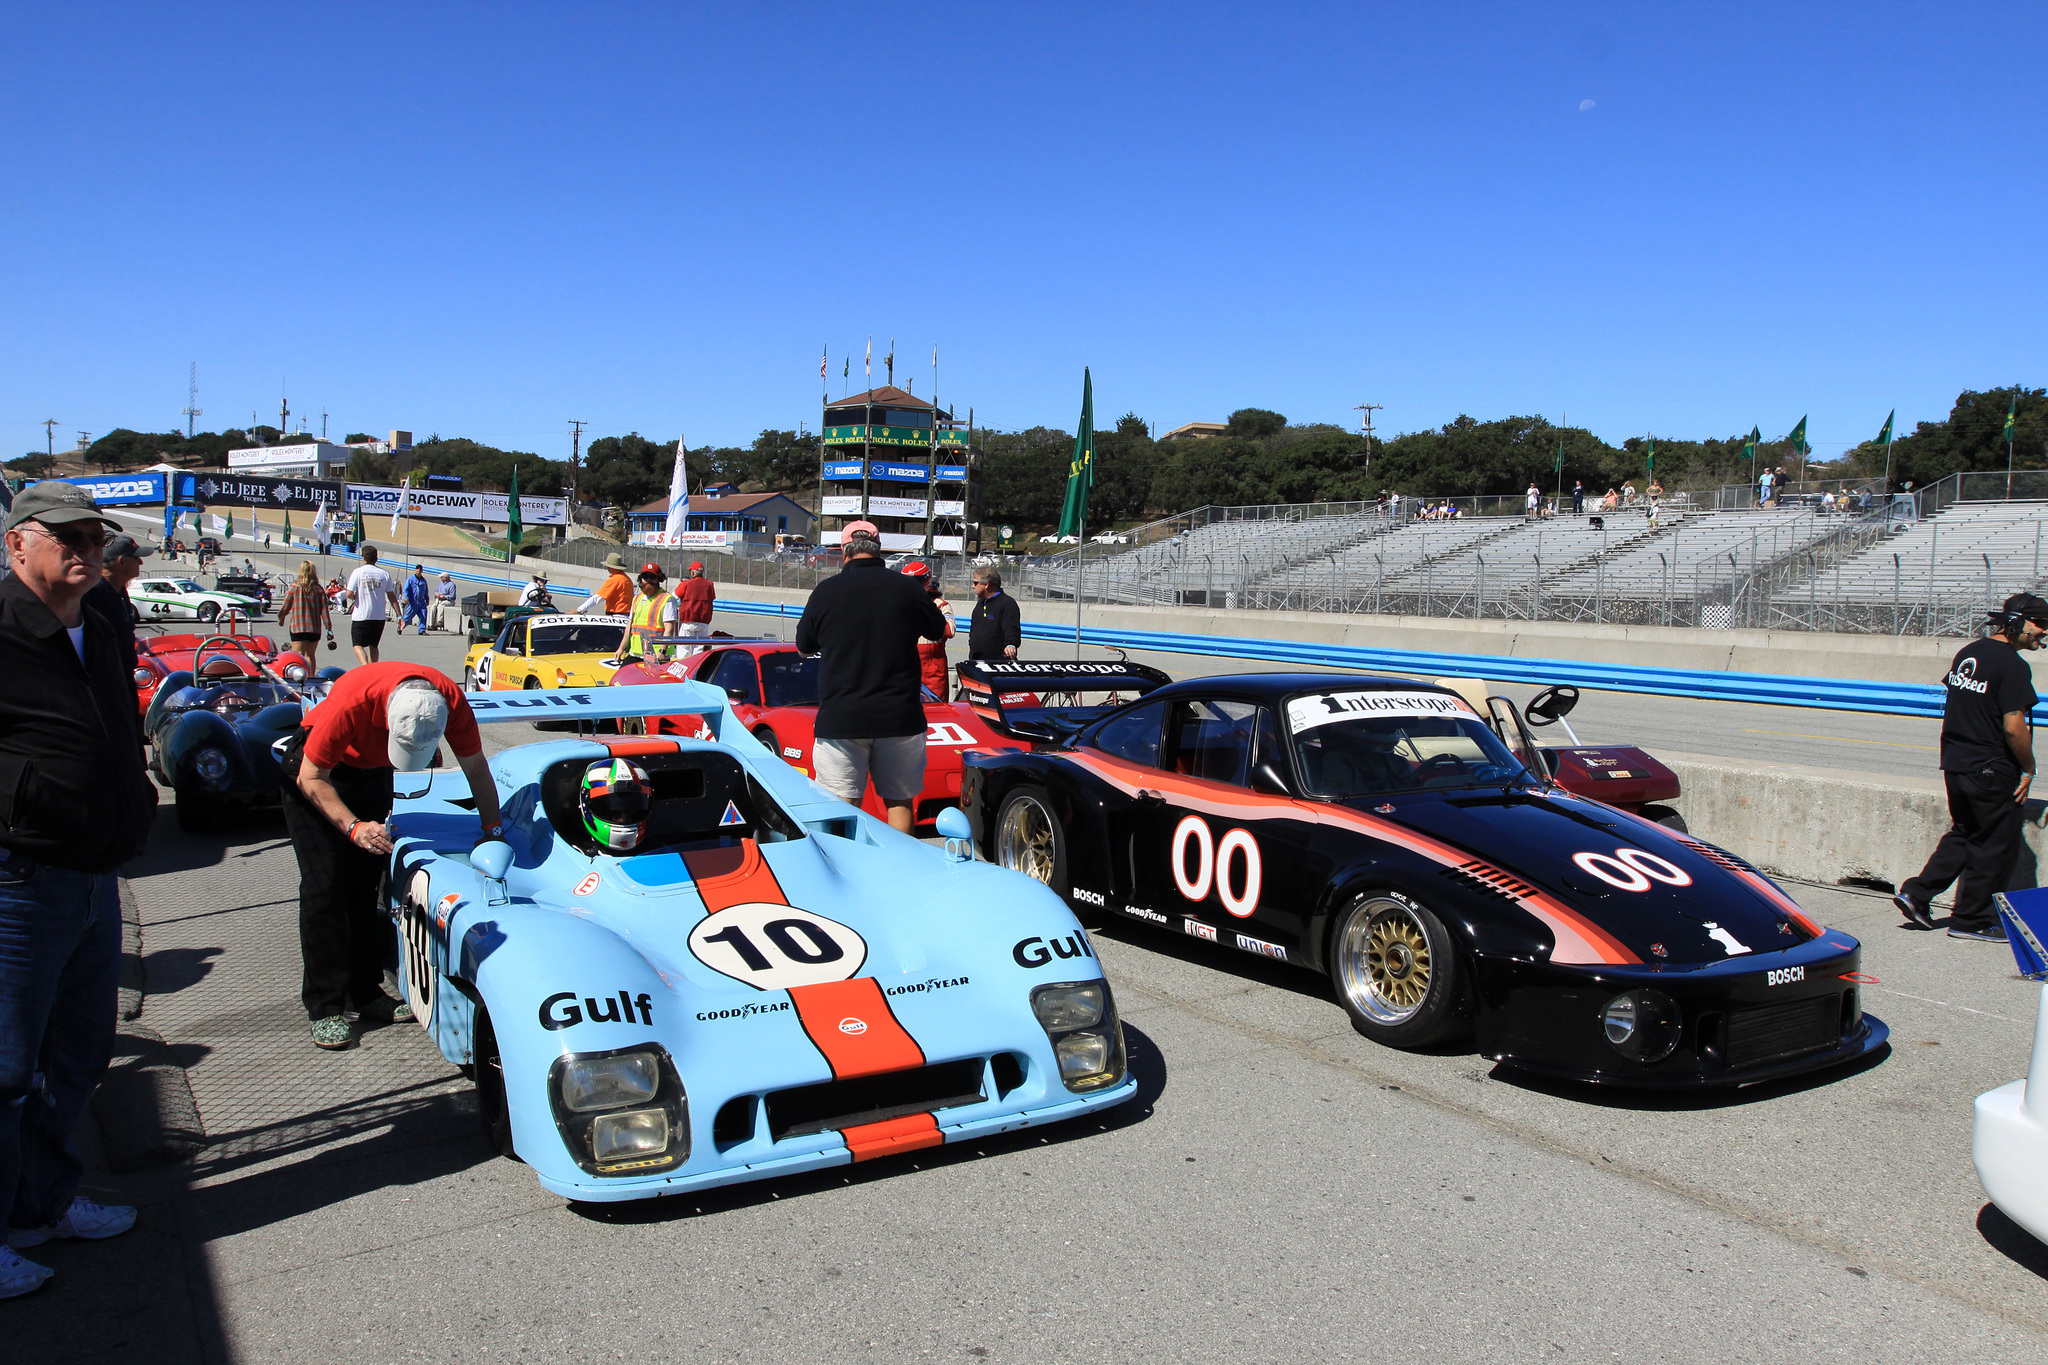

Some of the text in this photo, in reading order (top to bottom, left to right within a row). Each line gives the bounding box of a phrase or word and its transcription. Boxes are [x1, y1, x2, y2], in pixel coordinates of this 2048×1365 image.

[825, 437, 843, 445] ROLEX
[872, 436, 929, 446] ROLEX ROLEX
[222, 481, 266, 498] EL JEFE
[294, 486, 337, 502] EL JEFE
[243, 495, 267, 503] TEQUILA
[409, 493, 477, 508] RACEWAY
[483, 499, 508, 507] ROLEX
[150, 603, 171, 613] 44
[537, 616, 577, 625] ZOTZ
[467, 693, 592, 710] Gulf
[783, 747, 803, 760] BBS
[1171, 814, 1263, 919] 00
[1572, 848, 1693, 893] 00
[578, 877, 596, 893] E
[1072, 886, 1105, 907] BOSCH
[1125, 904, 1168, 924] GOODYEAR
[1197, 925, 1215, 940] GT
[702, 917, 844, 972] 10
[1012, 929, 1093, 969] Gul
[1766, 965, 1806, 987] BOSCH
[886, 976, 970, 996] GOODYEAR
[538, 990, 654, 1032] Gulf
[696, 1001, 790, 1021] GOODYEAR
